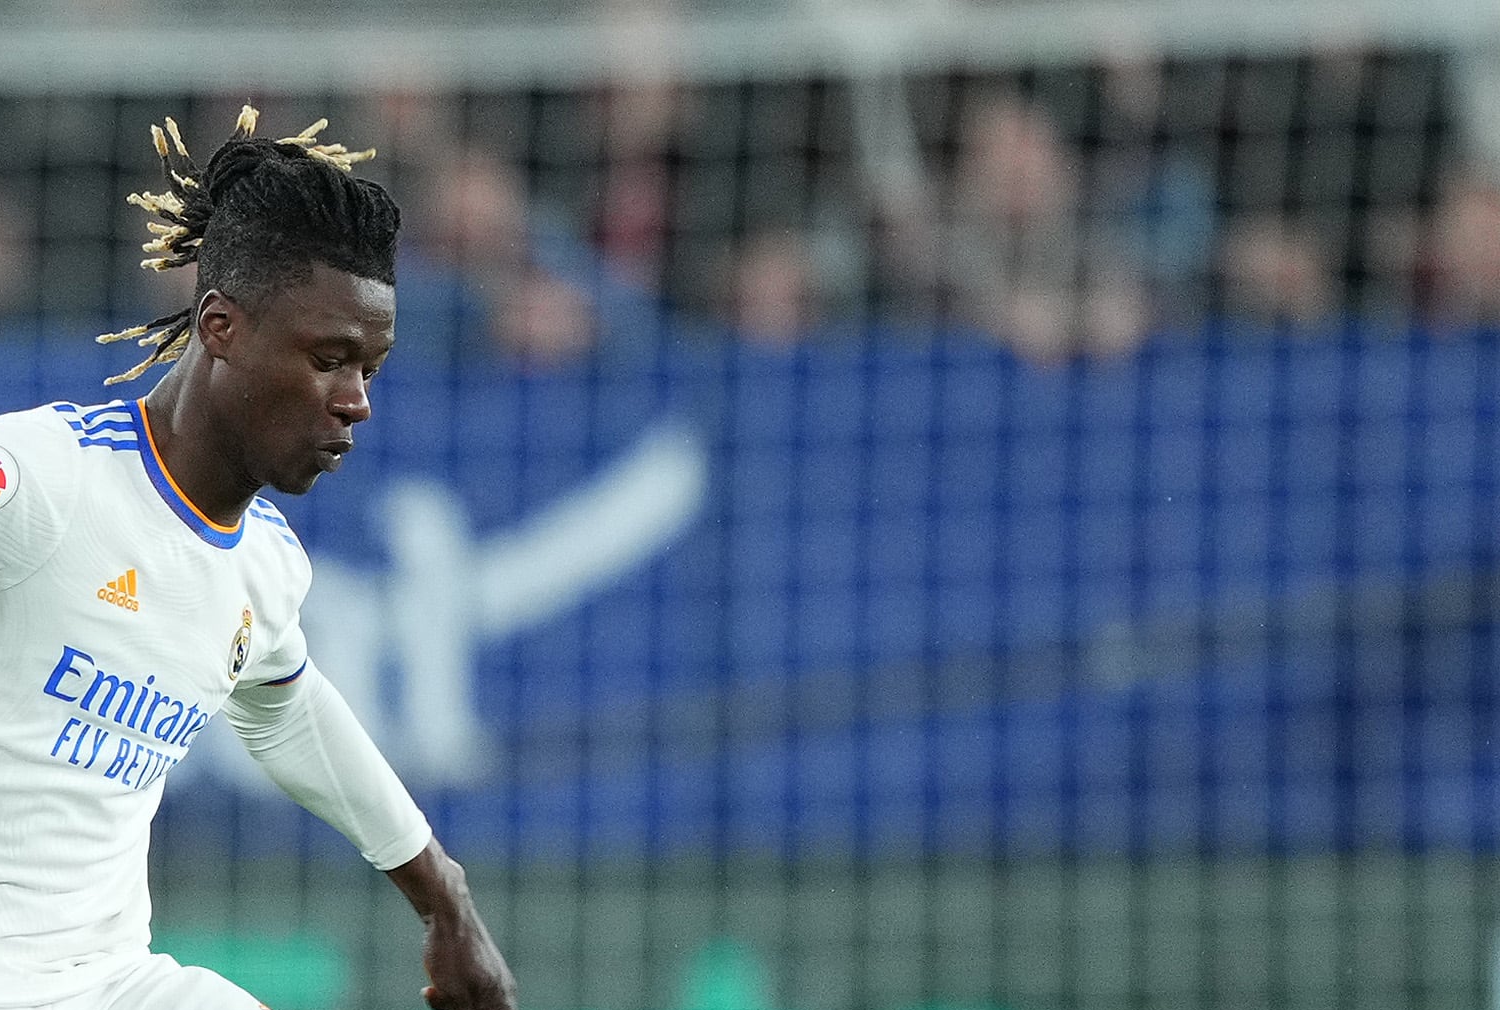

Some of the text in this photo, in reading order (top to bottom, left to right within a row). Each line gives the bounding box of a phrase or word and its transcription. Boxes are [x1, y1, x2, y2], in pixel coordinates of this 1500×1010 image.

[97, 588, 139, 612] adidas
[43, 645, 208, 748] Emirate
[50, 717, 178, 790] FLY BETTE
